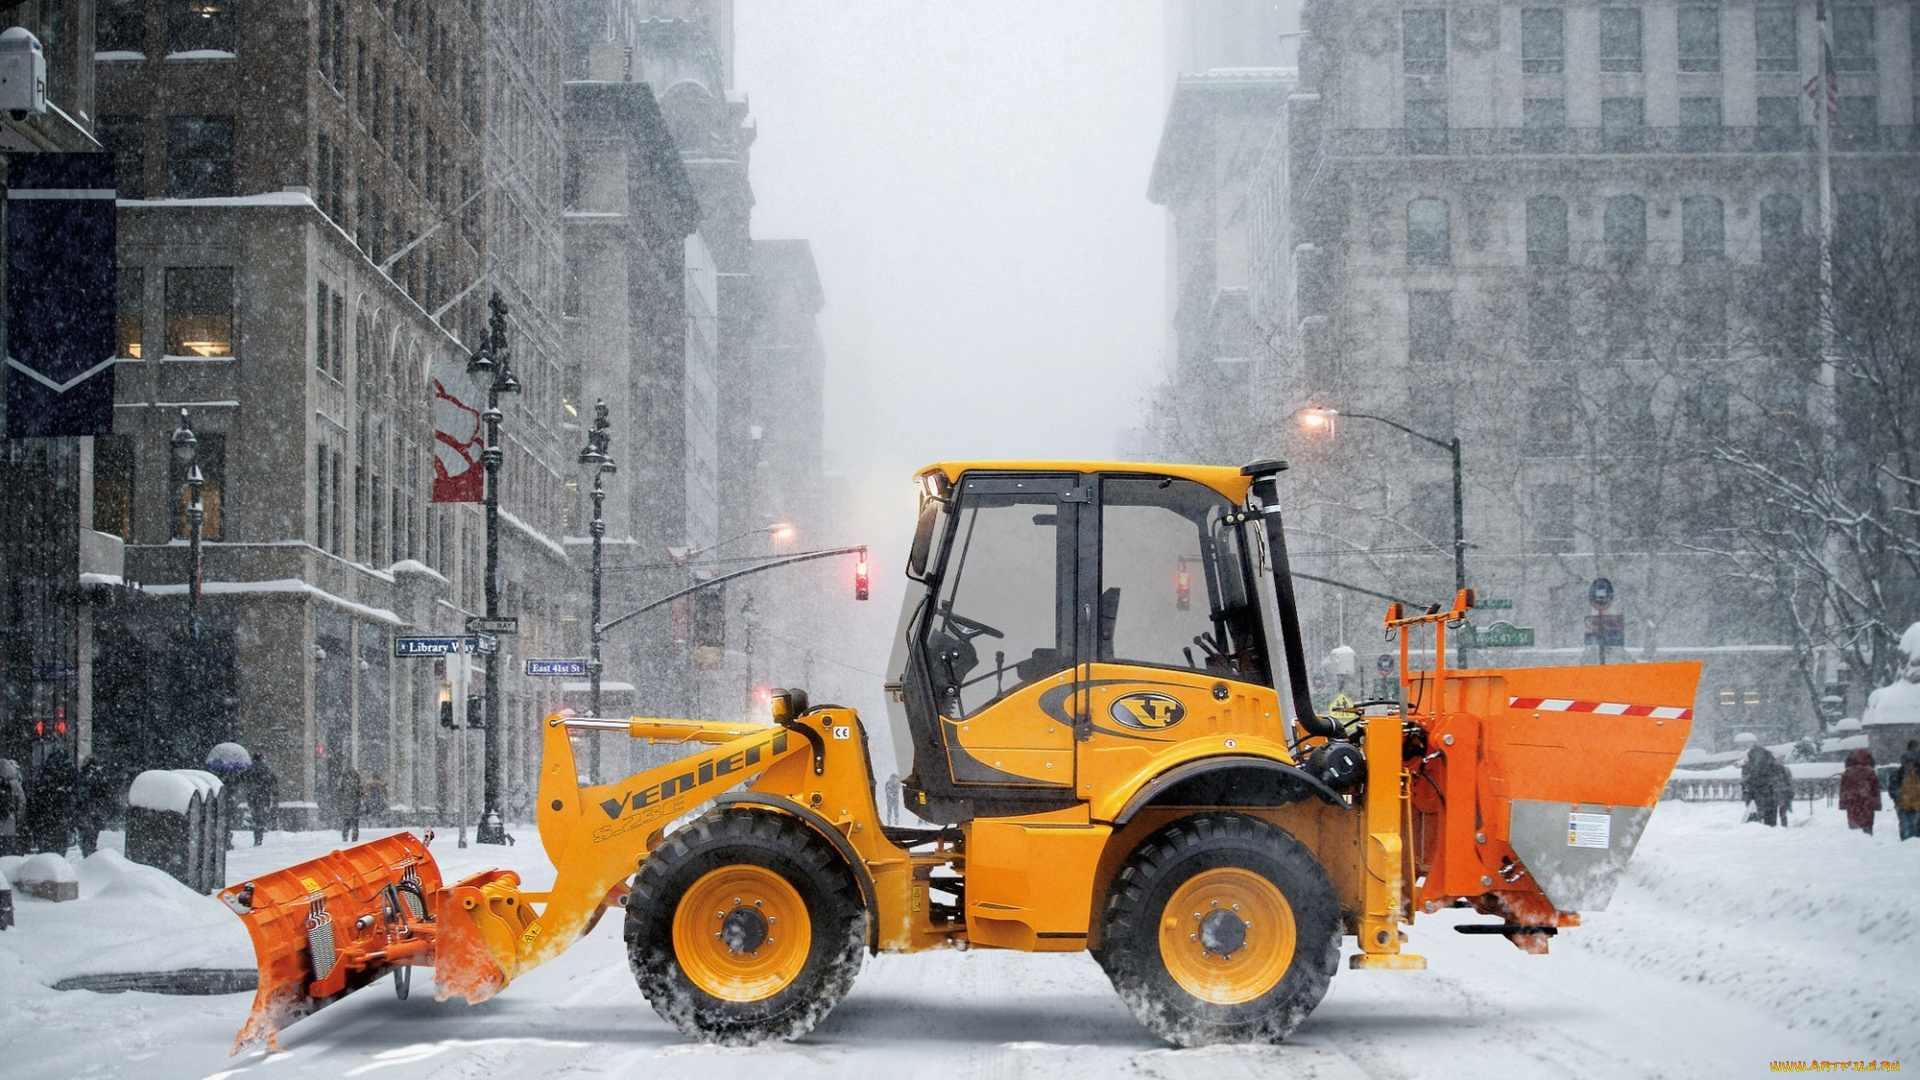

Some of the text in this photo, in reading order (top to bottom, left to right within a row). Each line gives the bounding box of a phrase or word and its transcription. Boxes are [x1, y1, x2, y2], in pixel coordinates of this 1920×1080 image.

[472, 621, 487, 630] ONE
[1518, 633, 1528, 643] St
[409, 642, 449, 654] Library
[532, 663, 580, 673] East 41st St
[835, 727, 848, 738] CE
